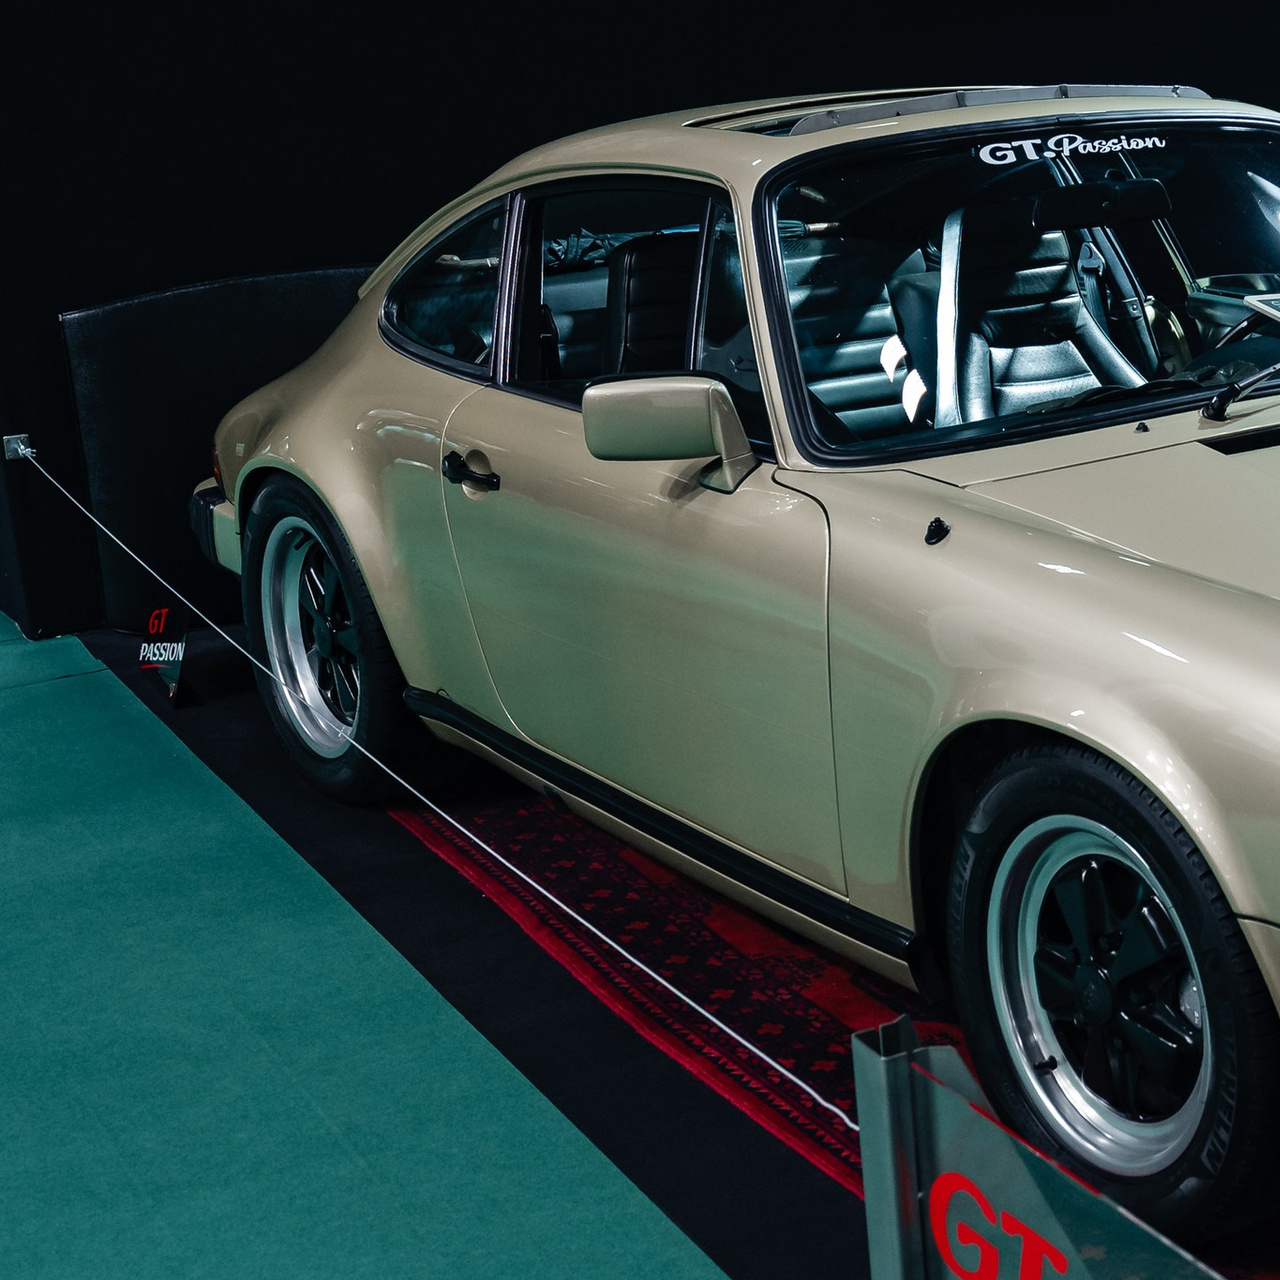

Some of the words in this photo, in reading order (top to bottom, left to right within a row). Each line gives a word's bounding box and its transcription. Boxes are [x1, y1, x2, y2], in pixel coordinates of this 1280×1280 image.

[1047, 133, 1166, 156] Passion
[148, 608, 170, 635] GT
[139, 642, 185, 662] PASSION
